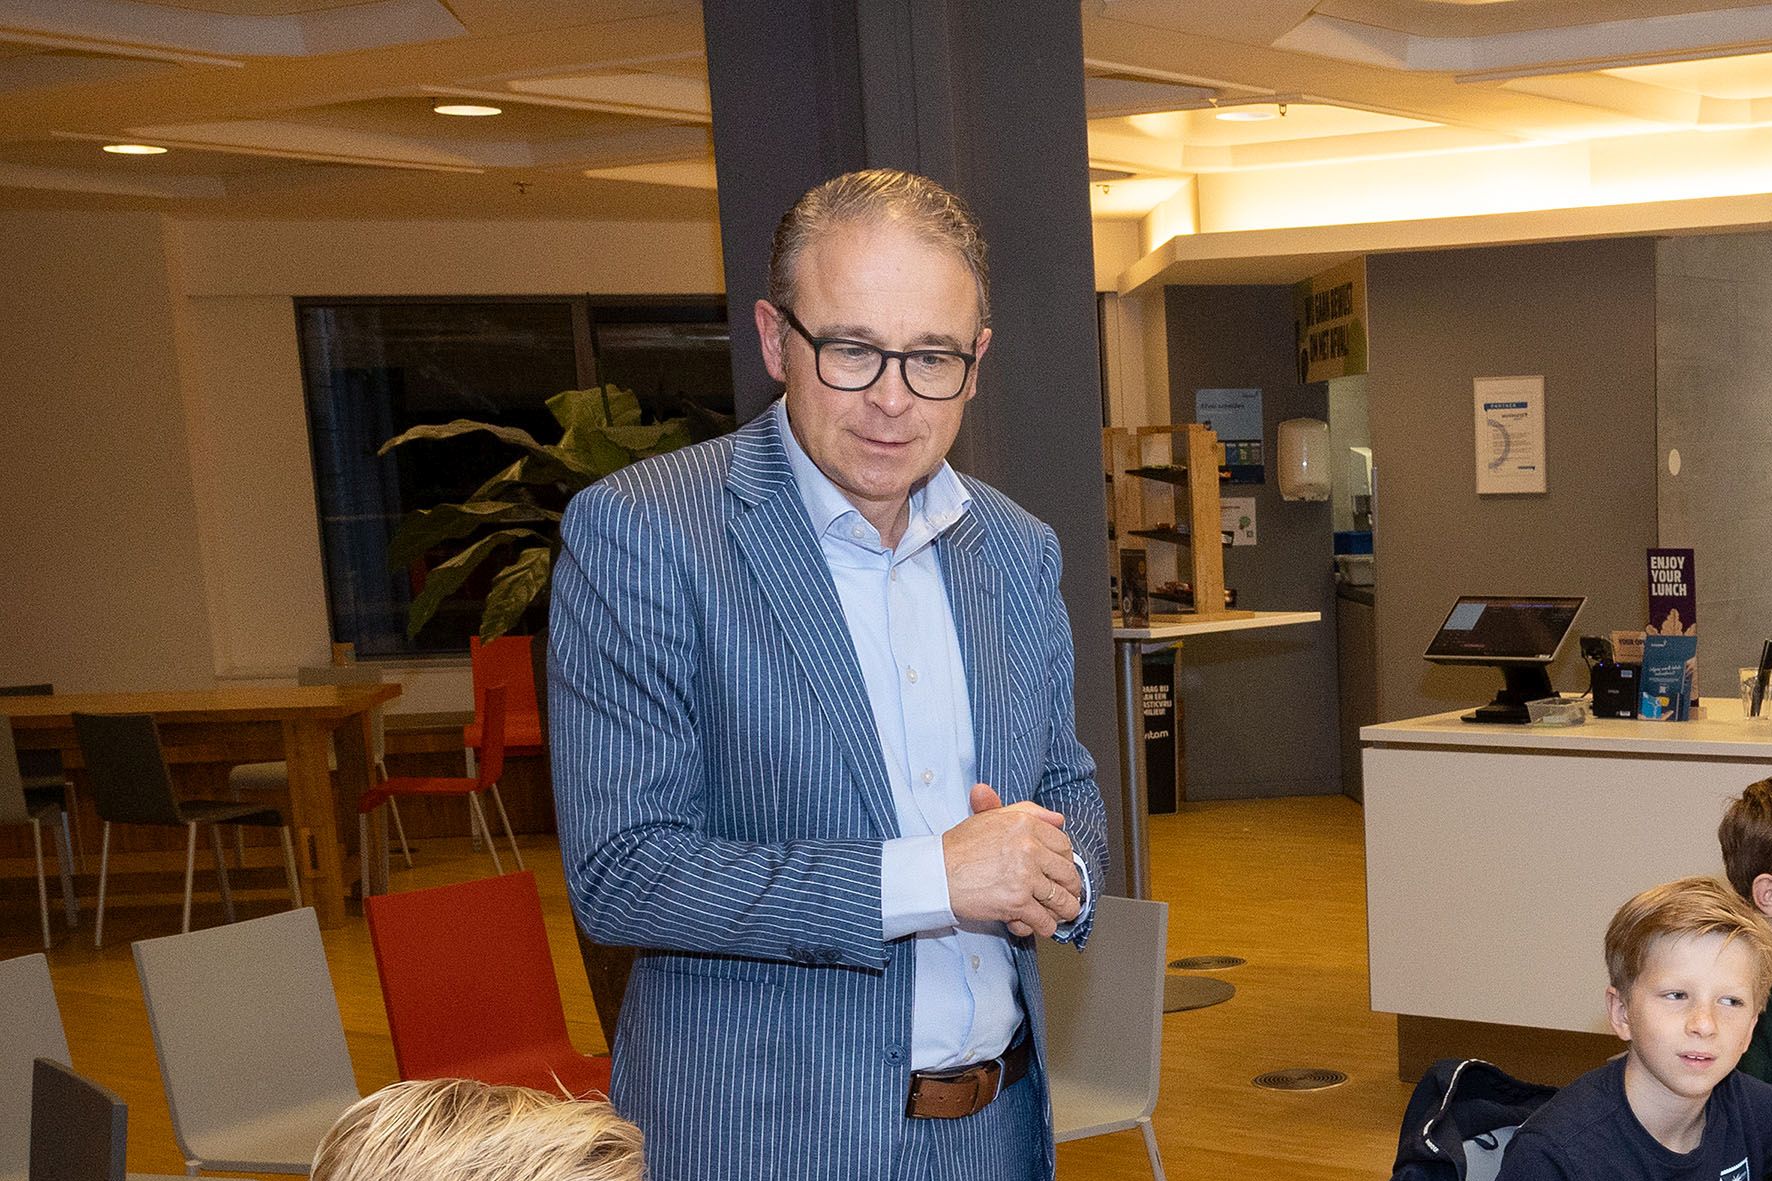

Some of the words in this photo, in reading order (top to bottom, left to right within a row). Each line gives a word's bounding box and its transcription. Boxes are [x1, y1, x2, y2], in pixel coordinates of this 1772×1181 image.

[1651, 556, 1685, 569] ENJOY
[1651, 570, 1681, 583] YOUR
[1652, 583, 1687, 596] LUNCH
